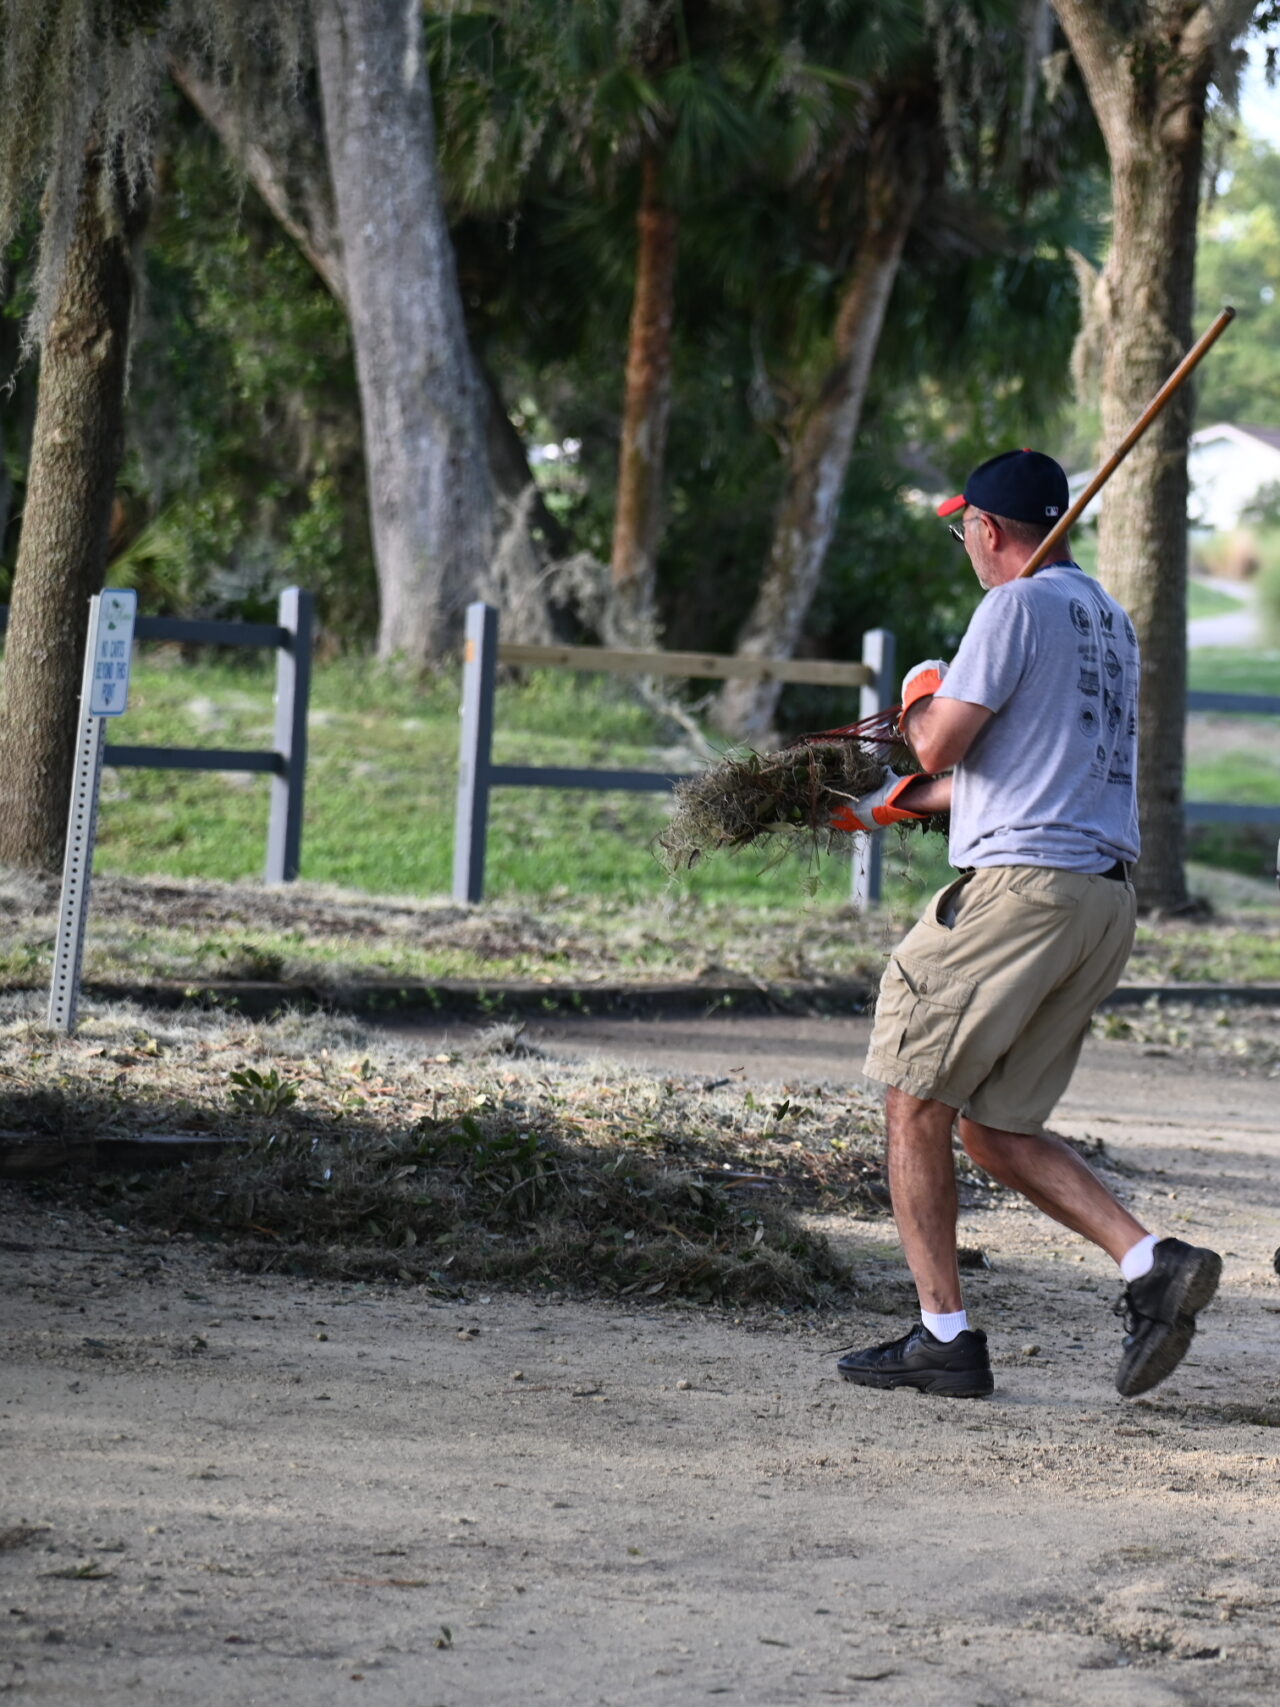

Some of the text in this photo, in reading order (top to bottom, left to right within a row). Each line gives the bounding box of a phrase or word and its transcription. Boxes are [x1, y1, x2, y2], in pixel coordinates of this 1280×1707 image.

[102, 640, 109, 657] NO
[95, 662, 127, 680] BEYOND THIS
[102, 683, 116, 698] POINT
